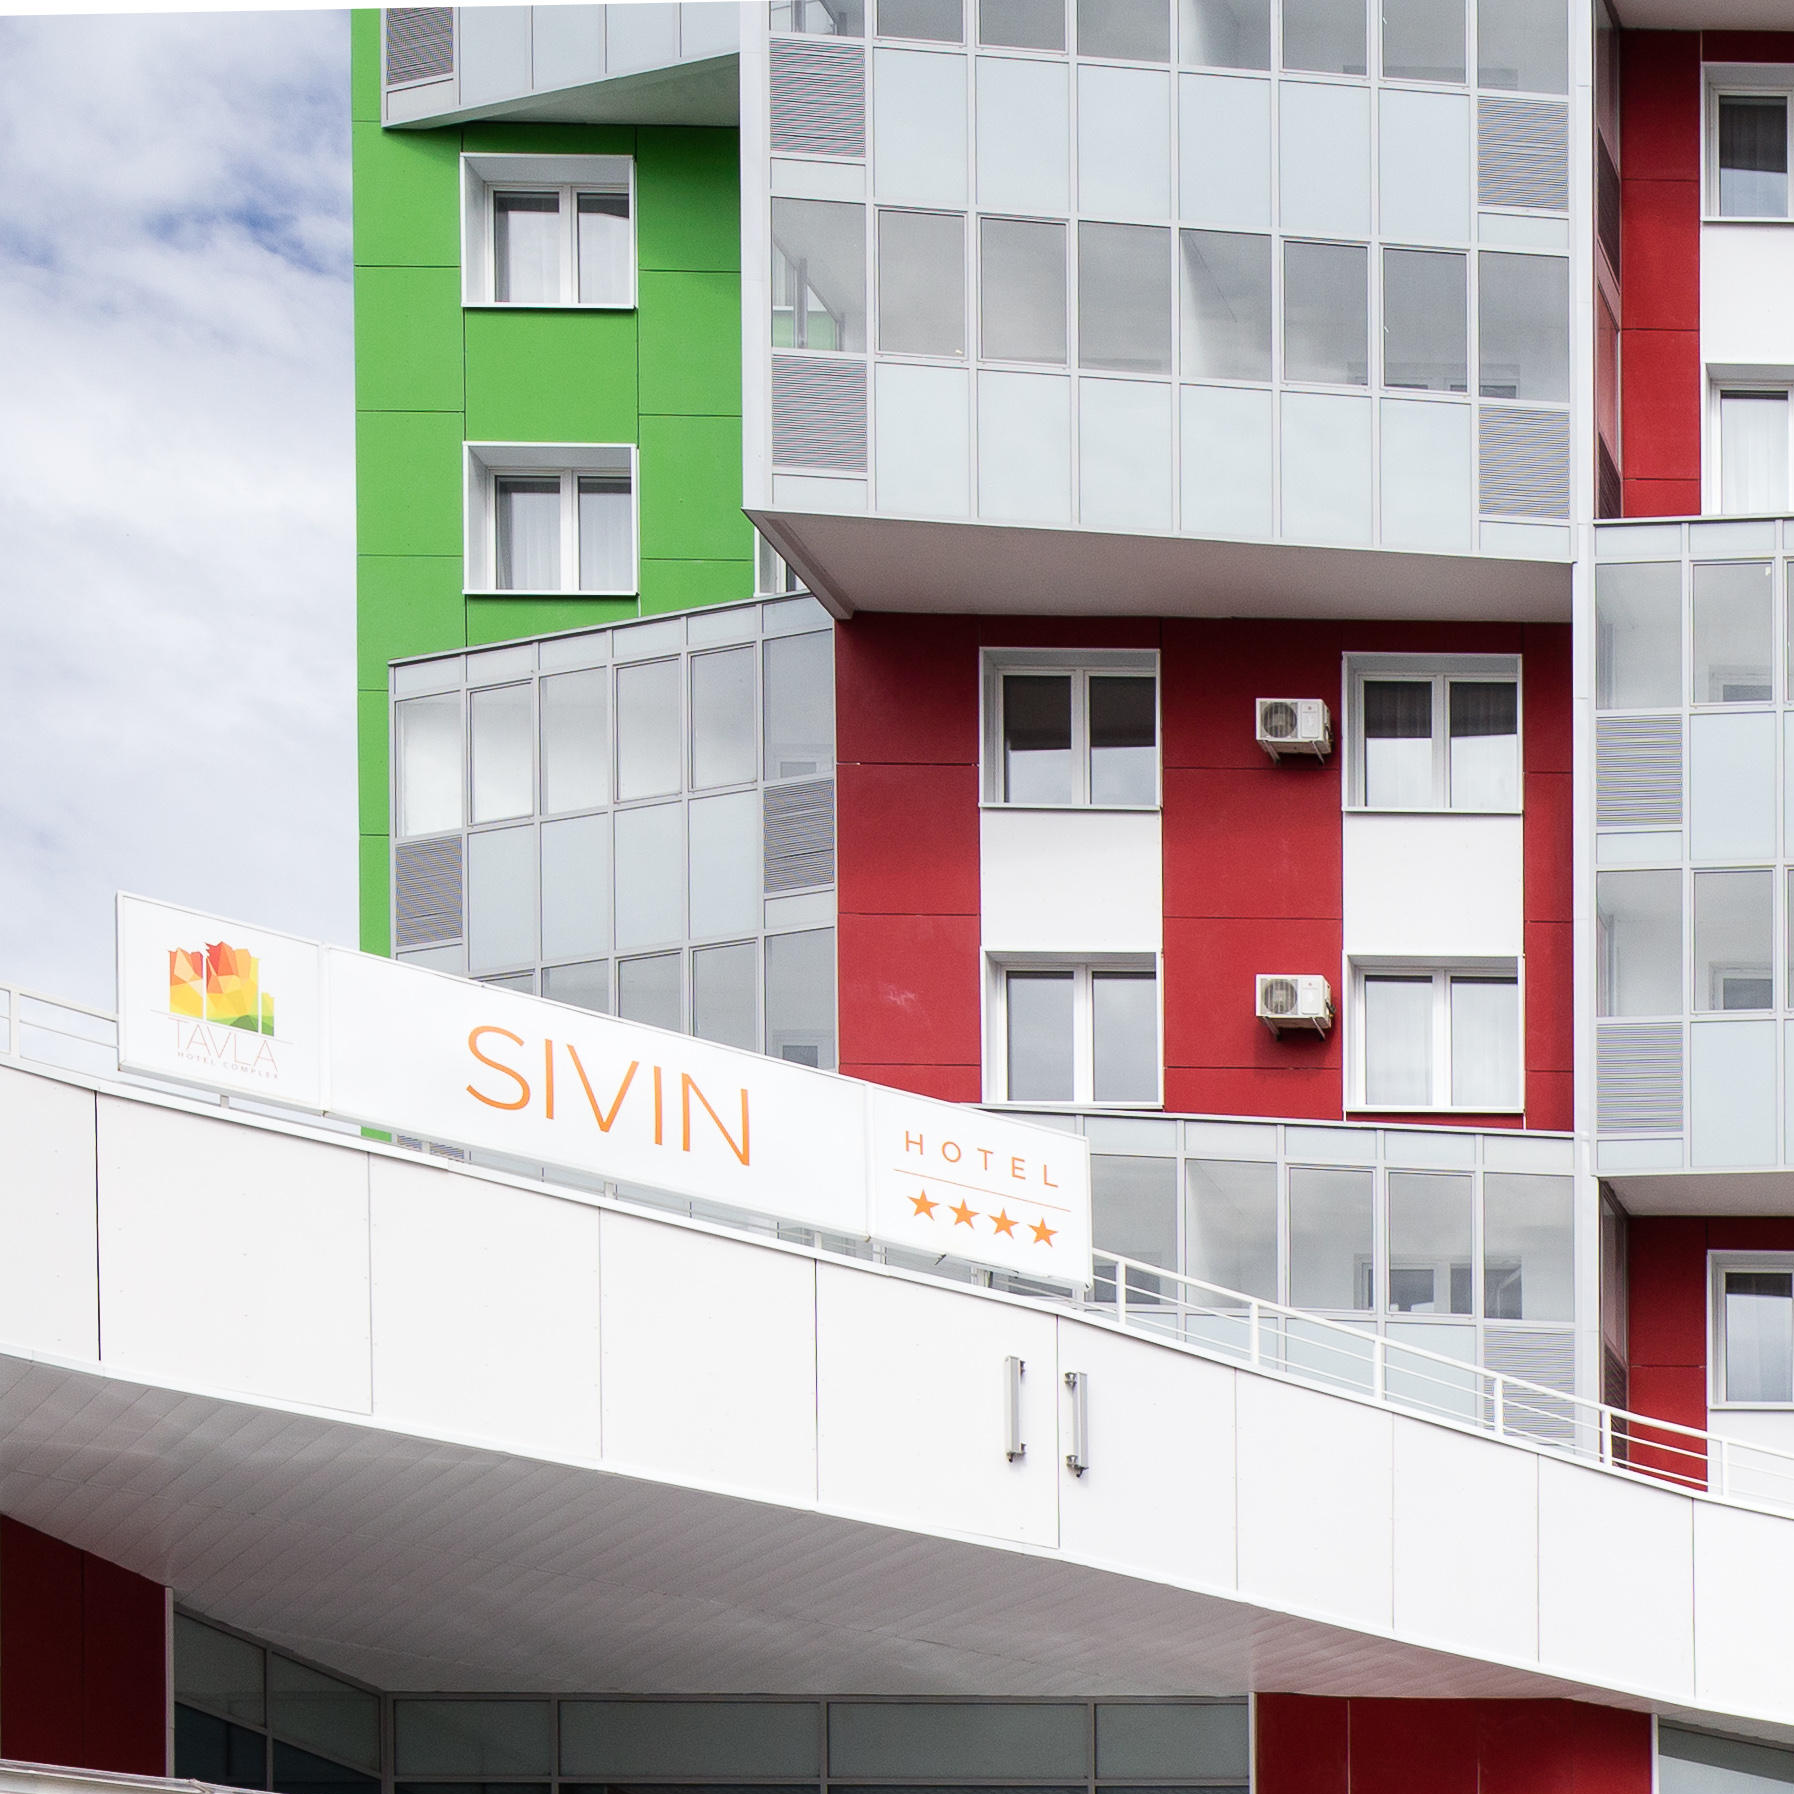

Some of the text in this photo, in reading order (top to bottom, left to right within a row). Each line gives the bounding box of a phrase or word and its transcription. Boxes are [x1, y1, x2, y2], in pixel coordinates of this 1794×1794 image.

[168, 1017, 278, 1072] TAVLA
[177, 1051, 279, 1080] HOTEL COMPLEX
[466, 1026, 750, 1167] SIVIN
[905, 1130, 1059, 1188] HOTEL
